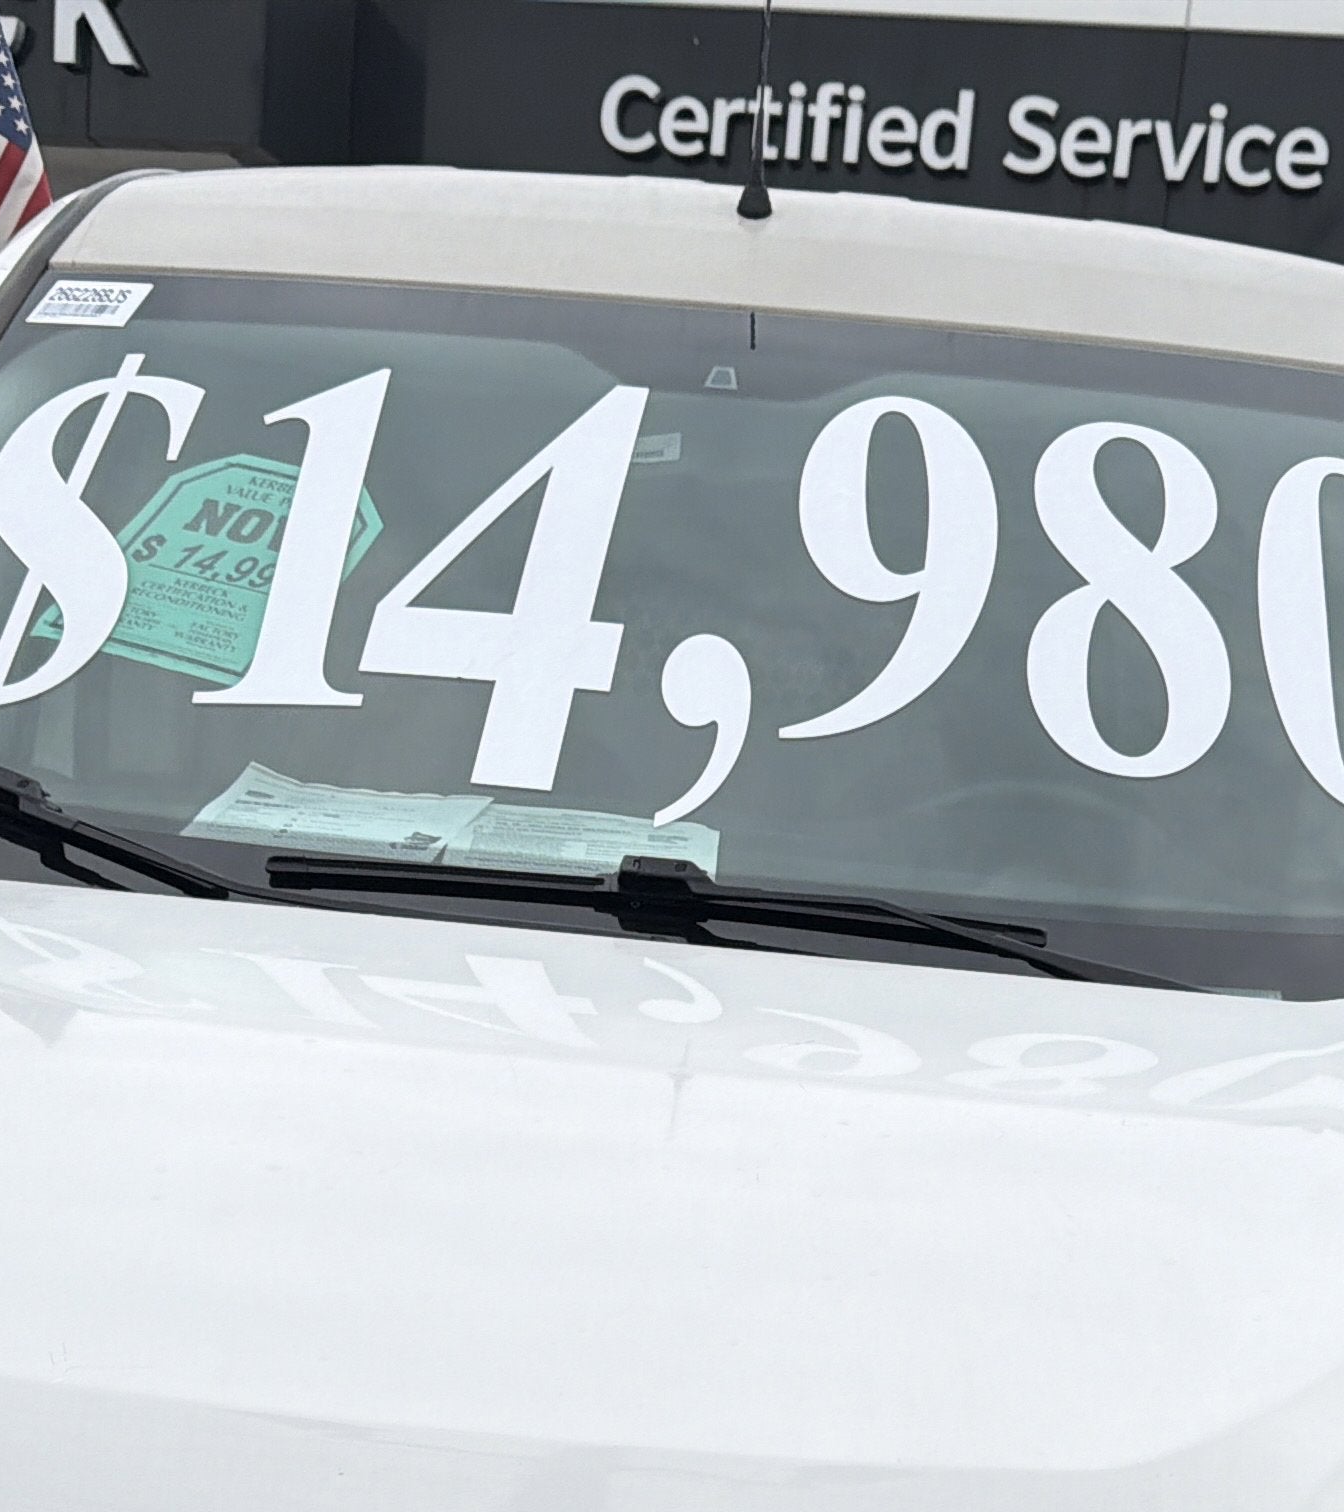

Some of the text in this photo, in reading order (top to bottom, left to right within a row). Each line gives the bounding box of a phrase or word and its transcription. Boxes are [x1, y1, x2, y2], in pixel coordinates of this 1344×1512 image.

[599, 74, 1331, 190] Certified Service
[173, 544, 275, 588] 14,99
